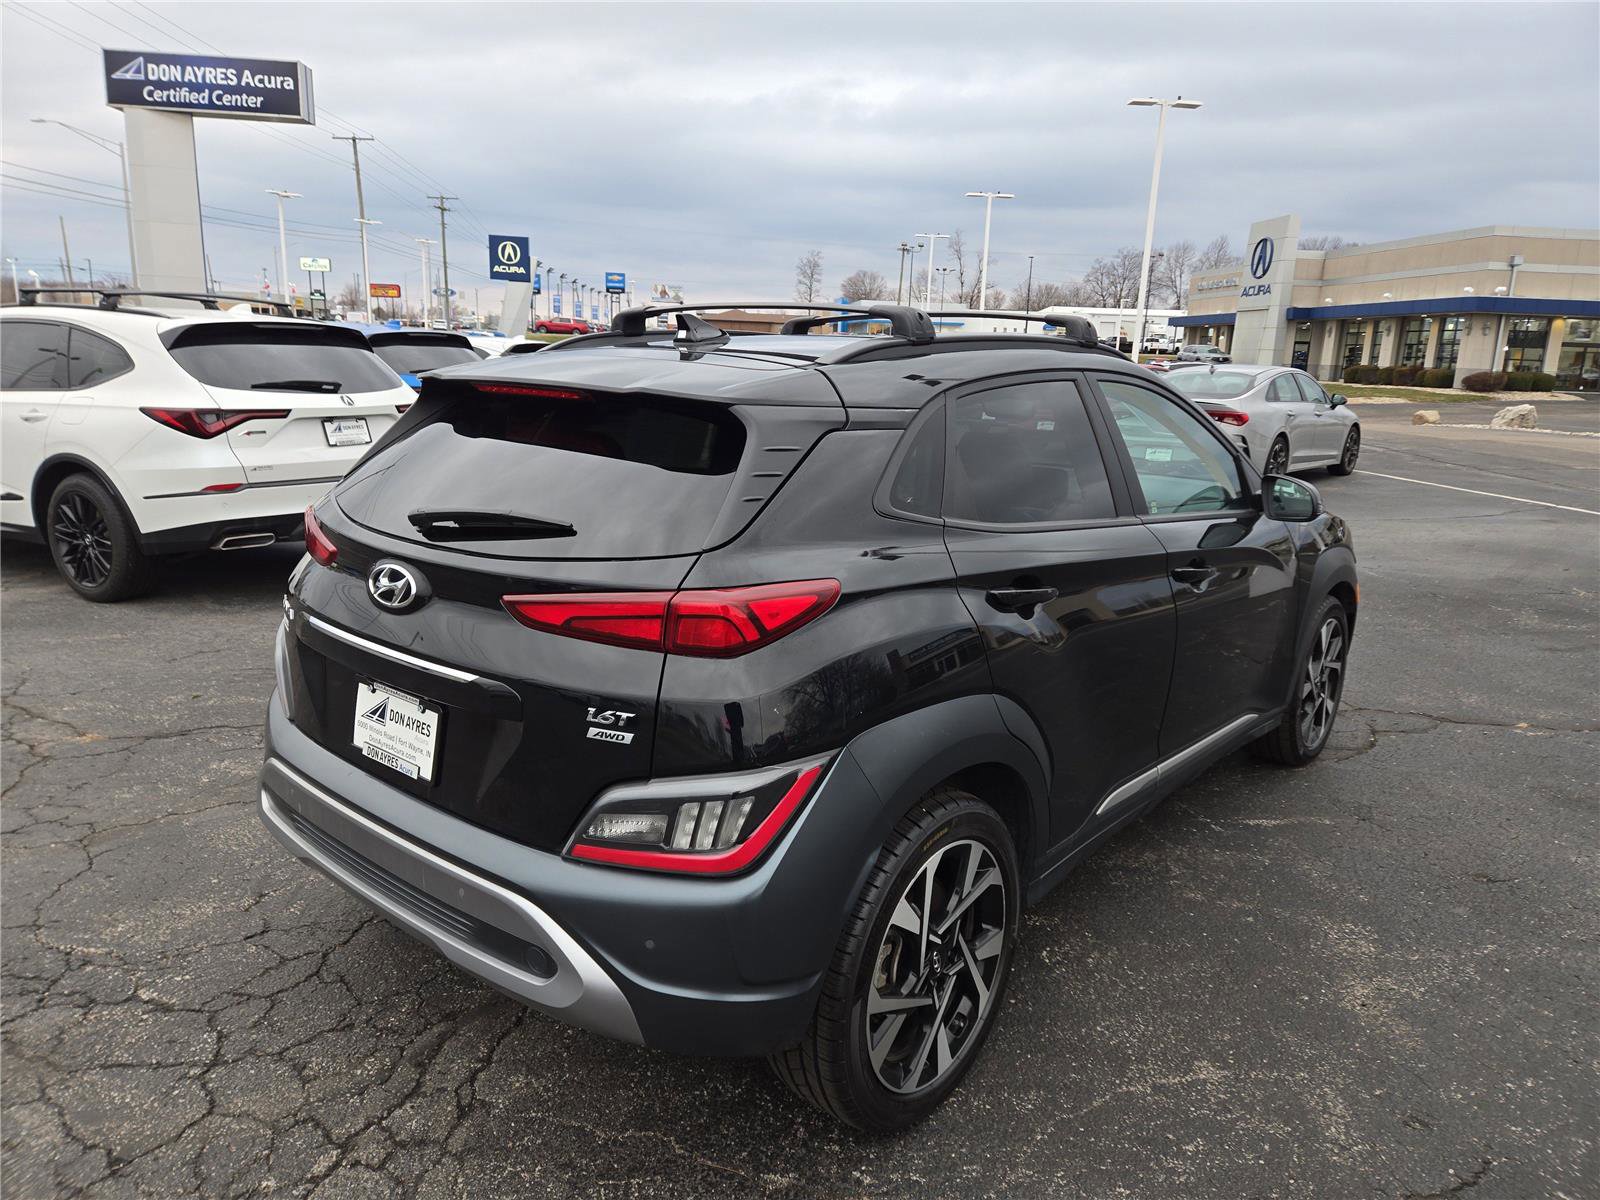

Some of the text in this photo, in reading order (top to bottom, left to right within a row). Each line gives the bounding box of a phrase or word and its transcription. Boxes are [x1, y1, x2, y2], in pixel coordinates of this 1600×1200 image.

[147, 63, 295, 91] DON AYRES Acura
[142, 86, 264, 108] Certified Center
[493, 265, 526, 274] ACURA
[1240, 284, 1272, 298] ACURA
[389, 708, 432, 738] DON AYRES
[593, 731, 626, 742] AWD
[366, 746, 414, 777] DON AYRES Acura
